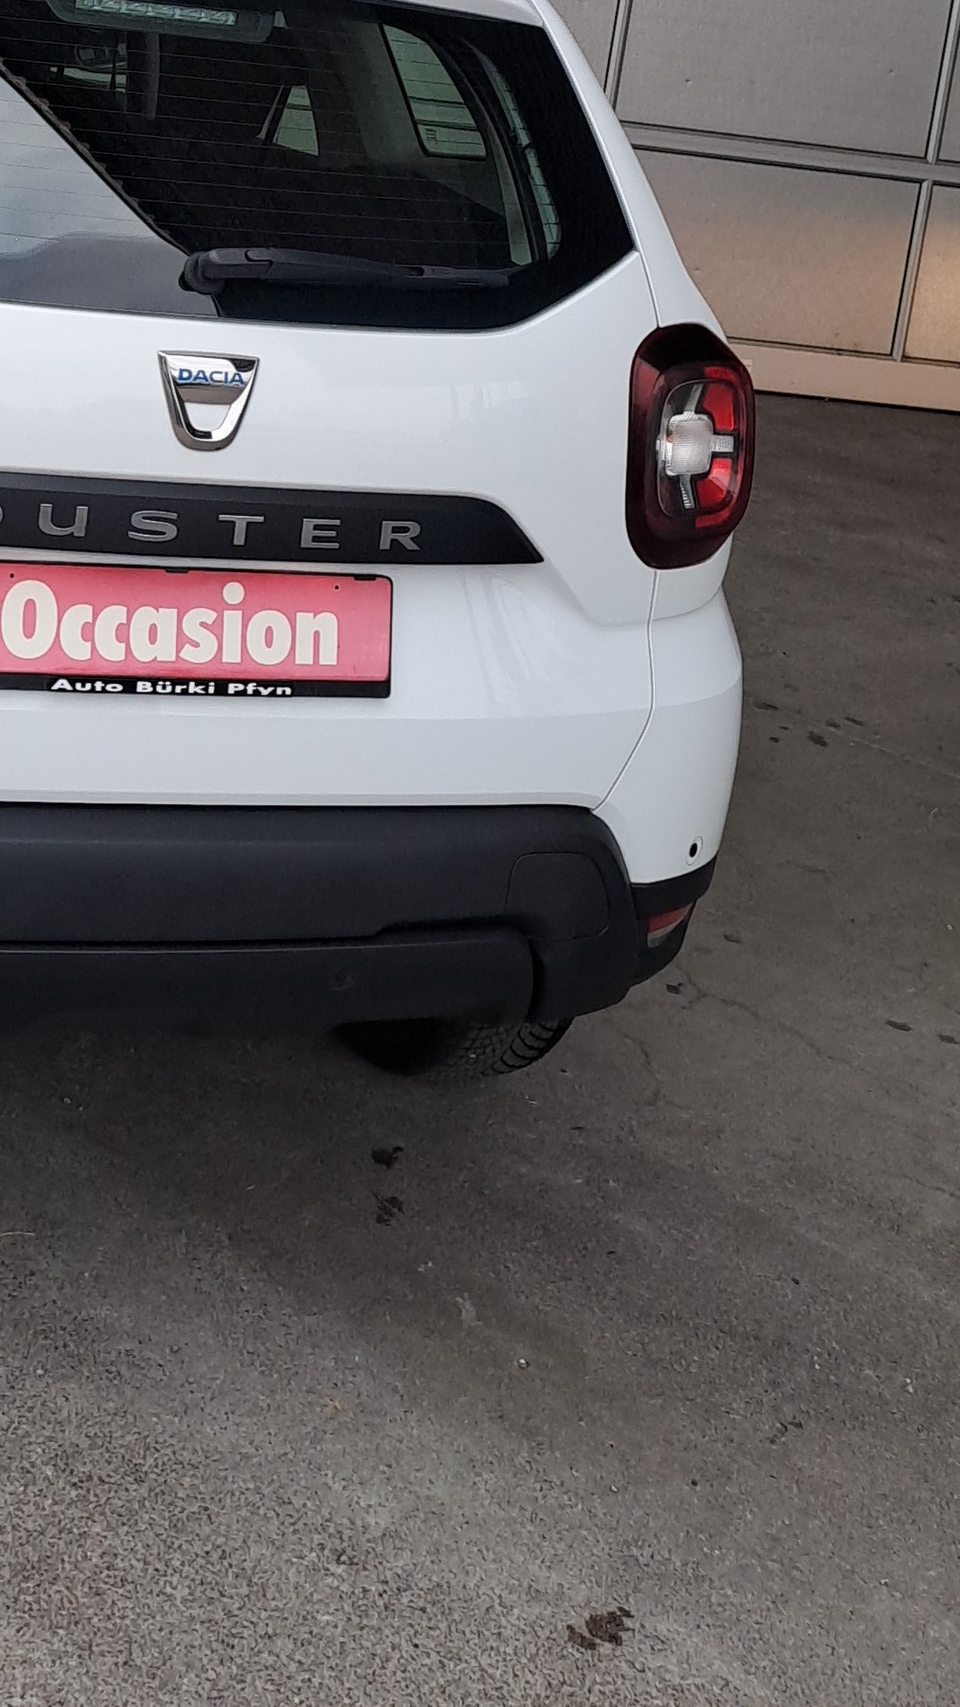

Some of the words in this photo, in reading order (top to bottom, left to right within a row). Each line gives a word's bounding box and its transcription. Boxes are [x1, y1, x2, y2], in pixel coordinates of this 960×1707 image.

[177, 368, 244, 385] DACIA
[0, 578, 339, 667] Occasion
[50, 678, 124, 693] Auto
[136, 680, 215, 695] Bürki
[227, 682, 292, 696] Pfyn
